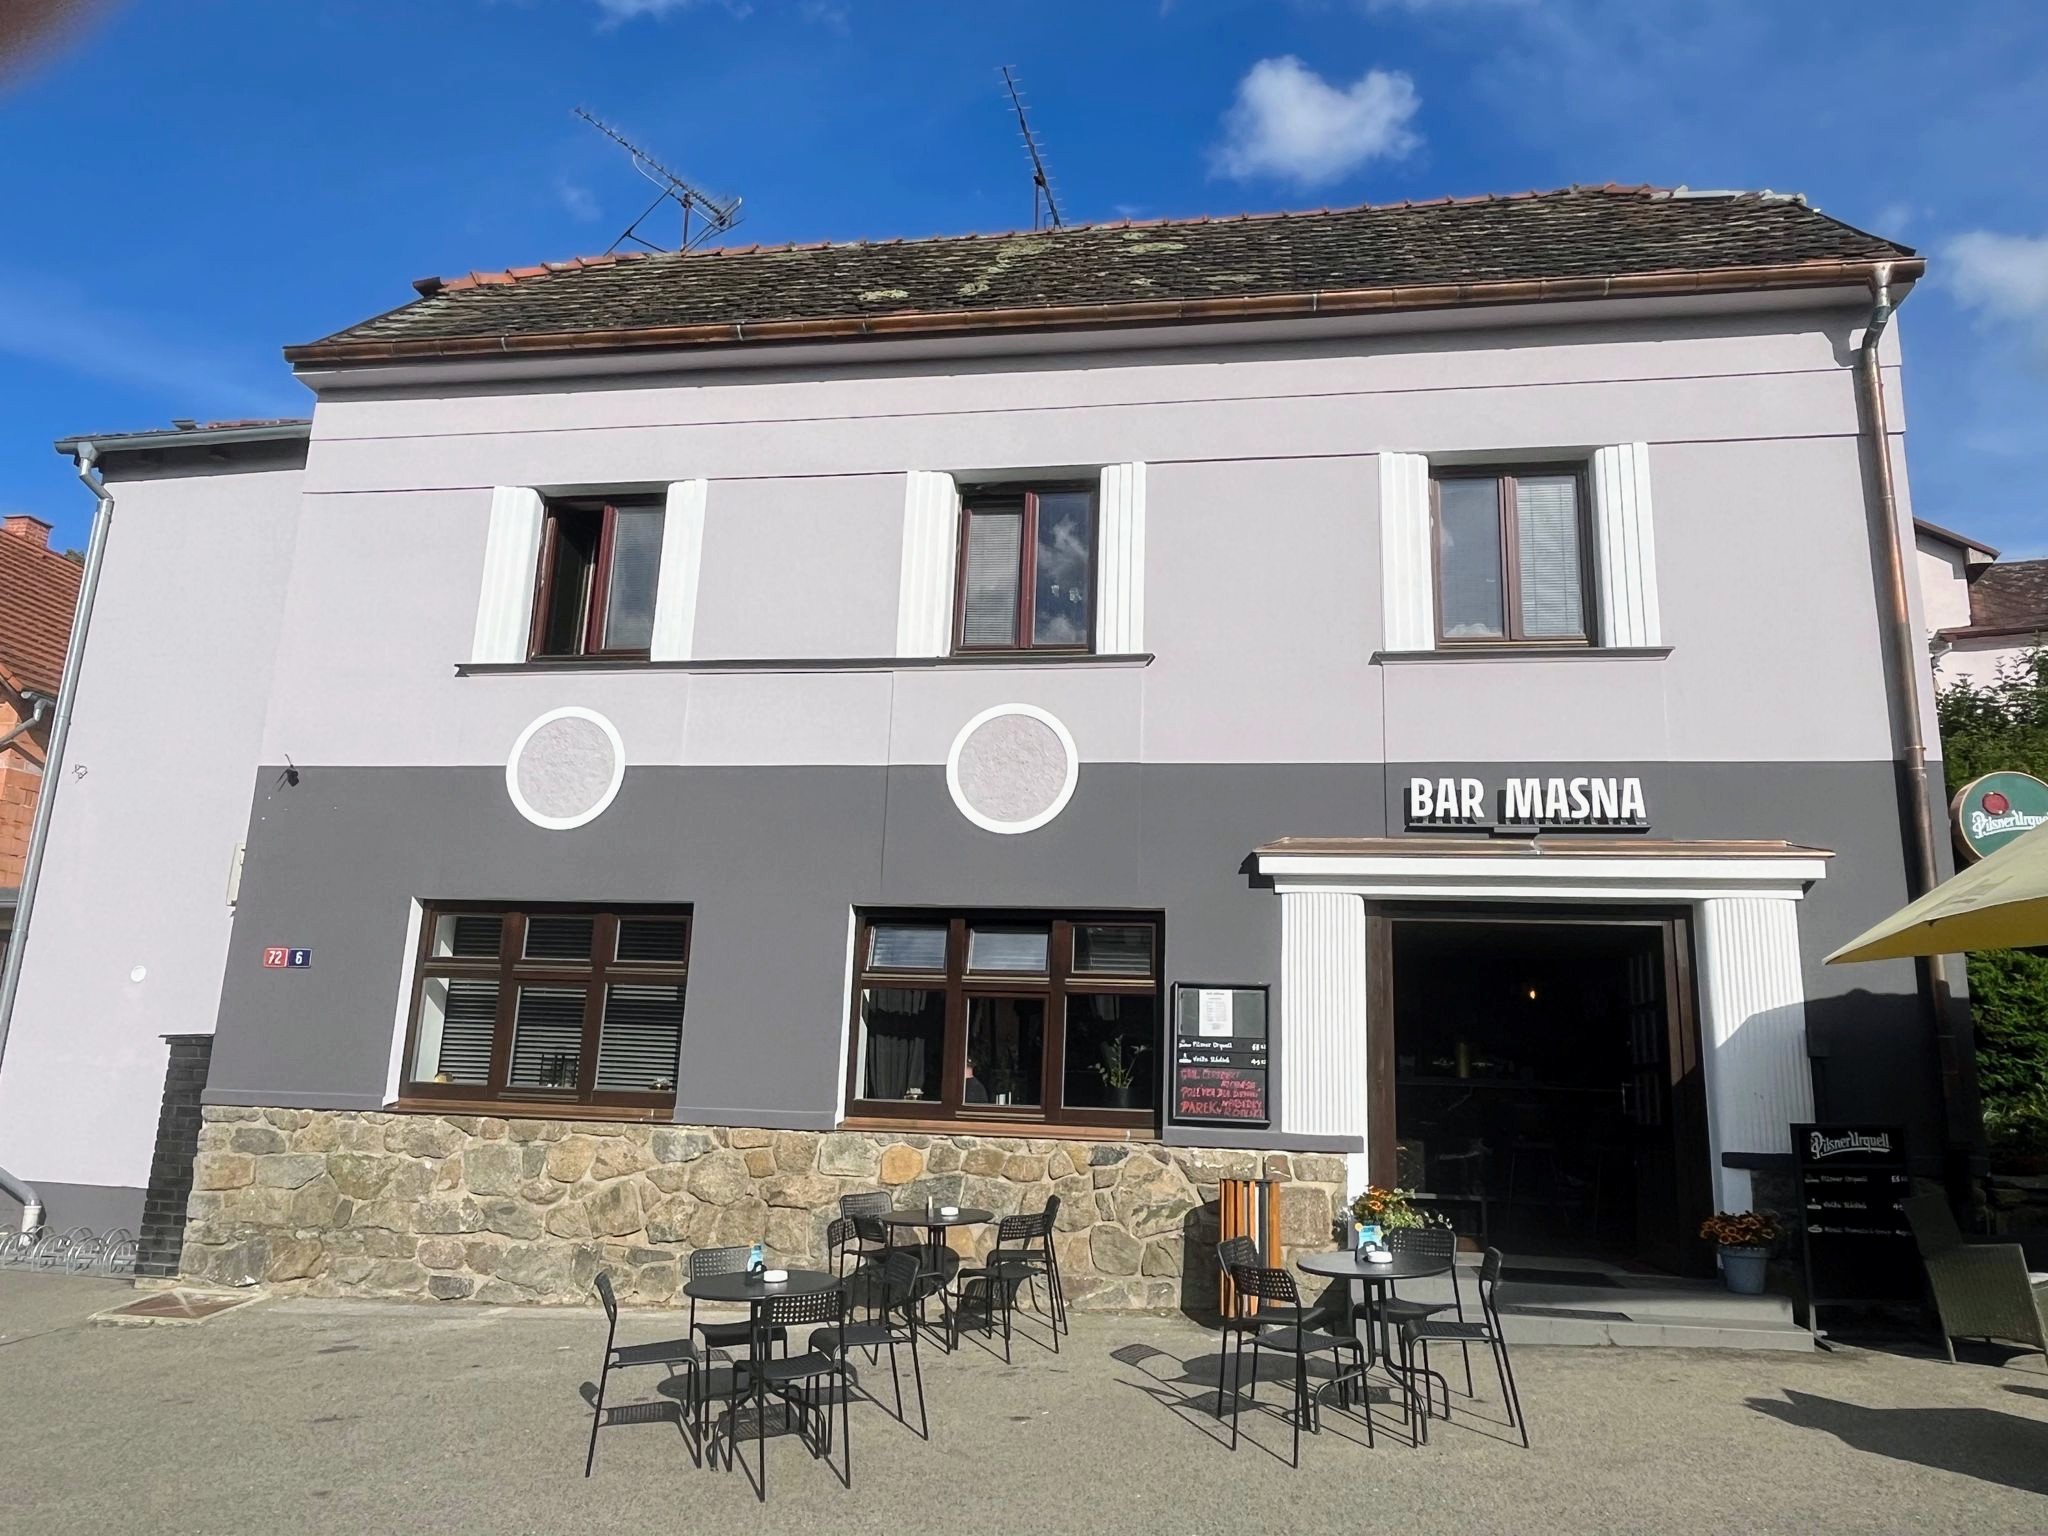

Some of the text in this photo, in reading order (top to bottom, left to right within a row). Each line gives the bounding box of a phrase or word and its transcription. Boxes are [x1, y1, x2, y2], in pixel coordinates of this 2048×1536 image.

[1410, 777, 1647, 819] BAR MASNA
[1971, 811, 2016, 839] Pilsner
[268, 950, 283, 965] 72
[295, 951, 304, 965] 6
[1810, 1130, 1892, 1160] Pilsner Urquell
